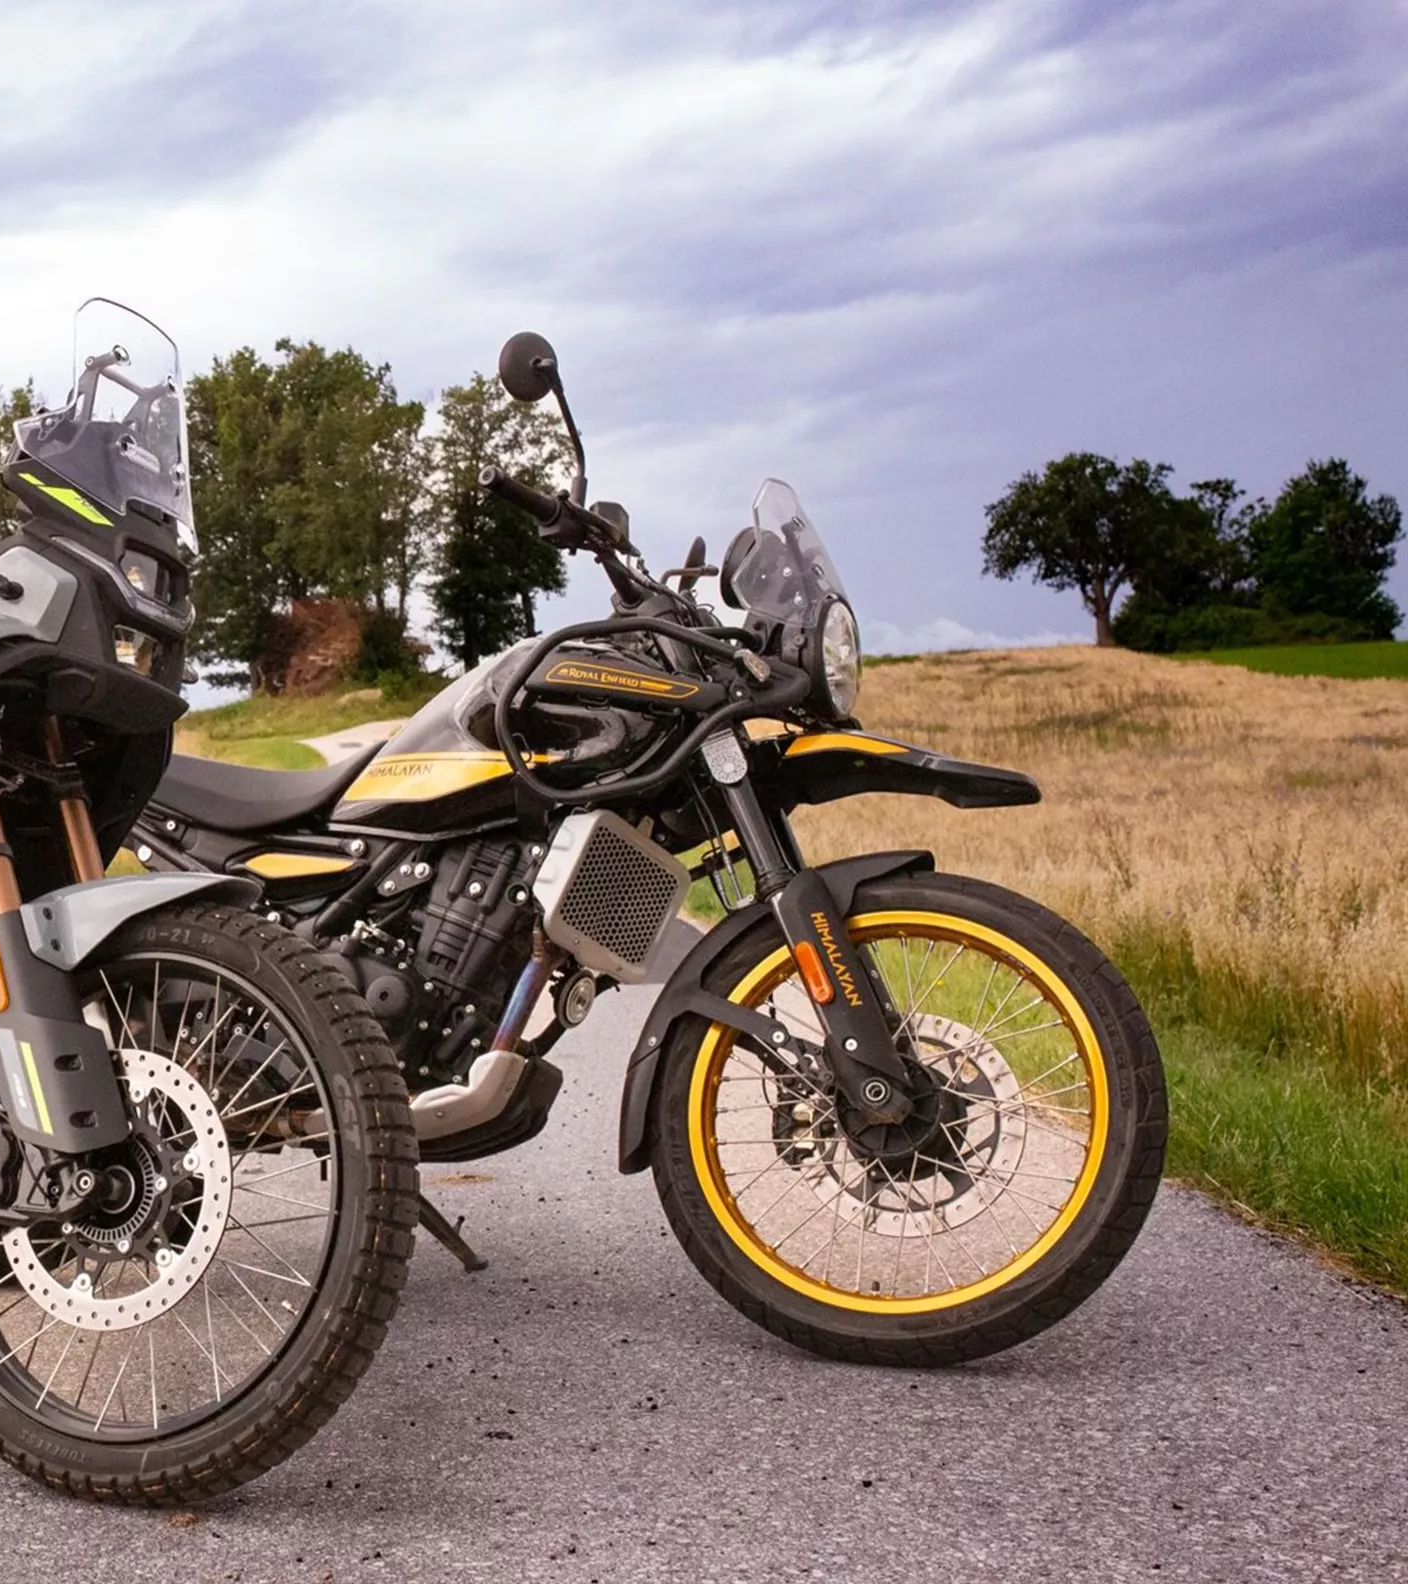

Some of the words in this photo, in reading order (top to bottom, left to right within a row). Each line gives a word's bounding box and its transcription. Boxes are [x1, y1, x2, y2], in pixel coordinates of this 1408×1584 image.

[567, 666, 599, 681] ROYAL
[600, 671, 640, 687] ENFIELD
[810, 911, 864, 1007] HIMALAYAN
[333, 1072, 362, 1150] CST
